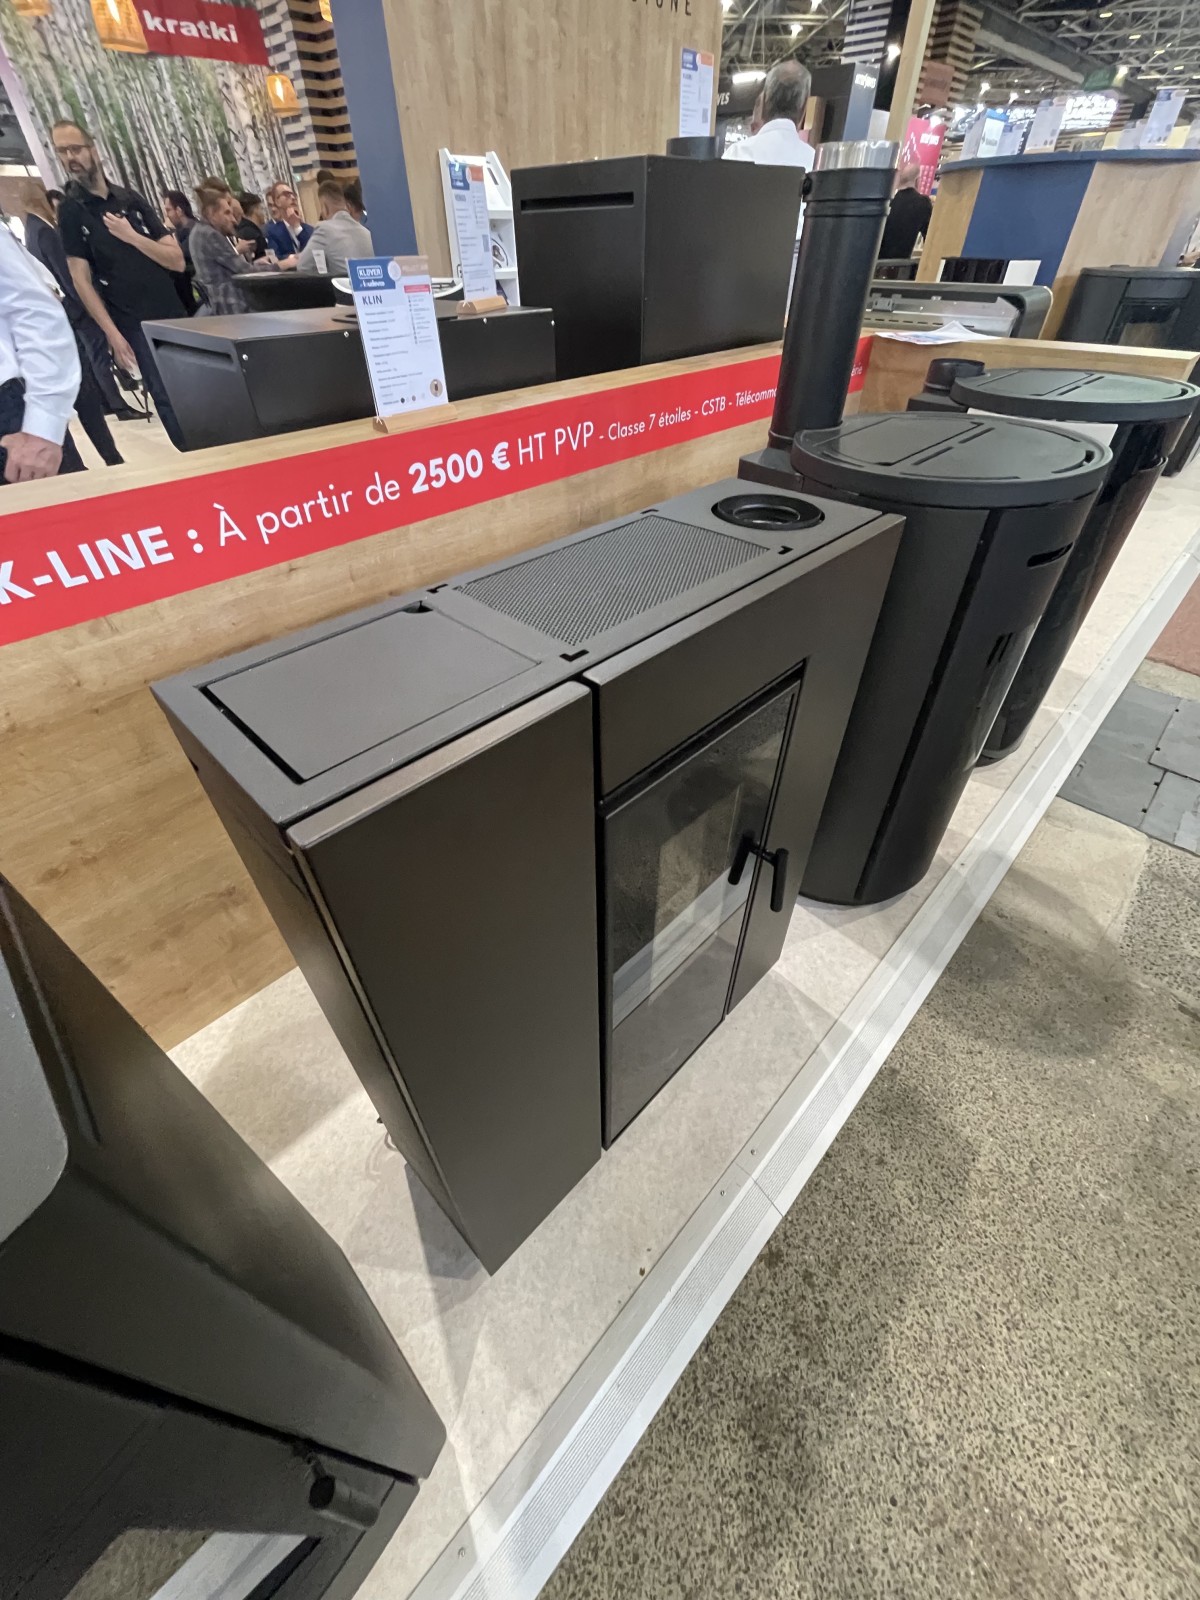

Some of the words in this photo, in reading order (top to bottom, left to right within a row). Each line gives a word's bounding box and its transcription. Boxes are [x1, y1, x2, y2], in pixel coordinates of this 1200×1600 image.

[142, 9, 239, 43] kratki
[362, 294, 383, 306] KLIN
[0, 525, 175, 605] K-LINE
[187, 528, 204, 554] :
[213, 502, 247, 547] À
[256, 483, 353, 545] partir
[365, 471, 401, 506] de
[408, 448, 483, 494] 2500
[491, 441, 511, 471] €
[518, 431, 547, 466] HT
[554, 421, 594, 456] PVP
[608, 421, 646, 441] Classe
[648, 413, 656, 431] 7
[658, 406, 691, 428] étoiles
[701, 396, 726, 417] CSTB
[735, 387, 778, 407] Télécomma
